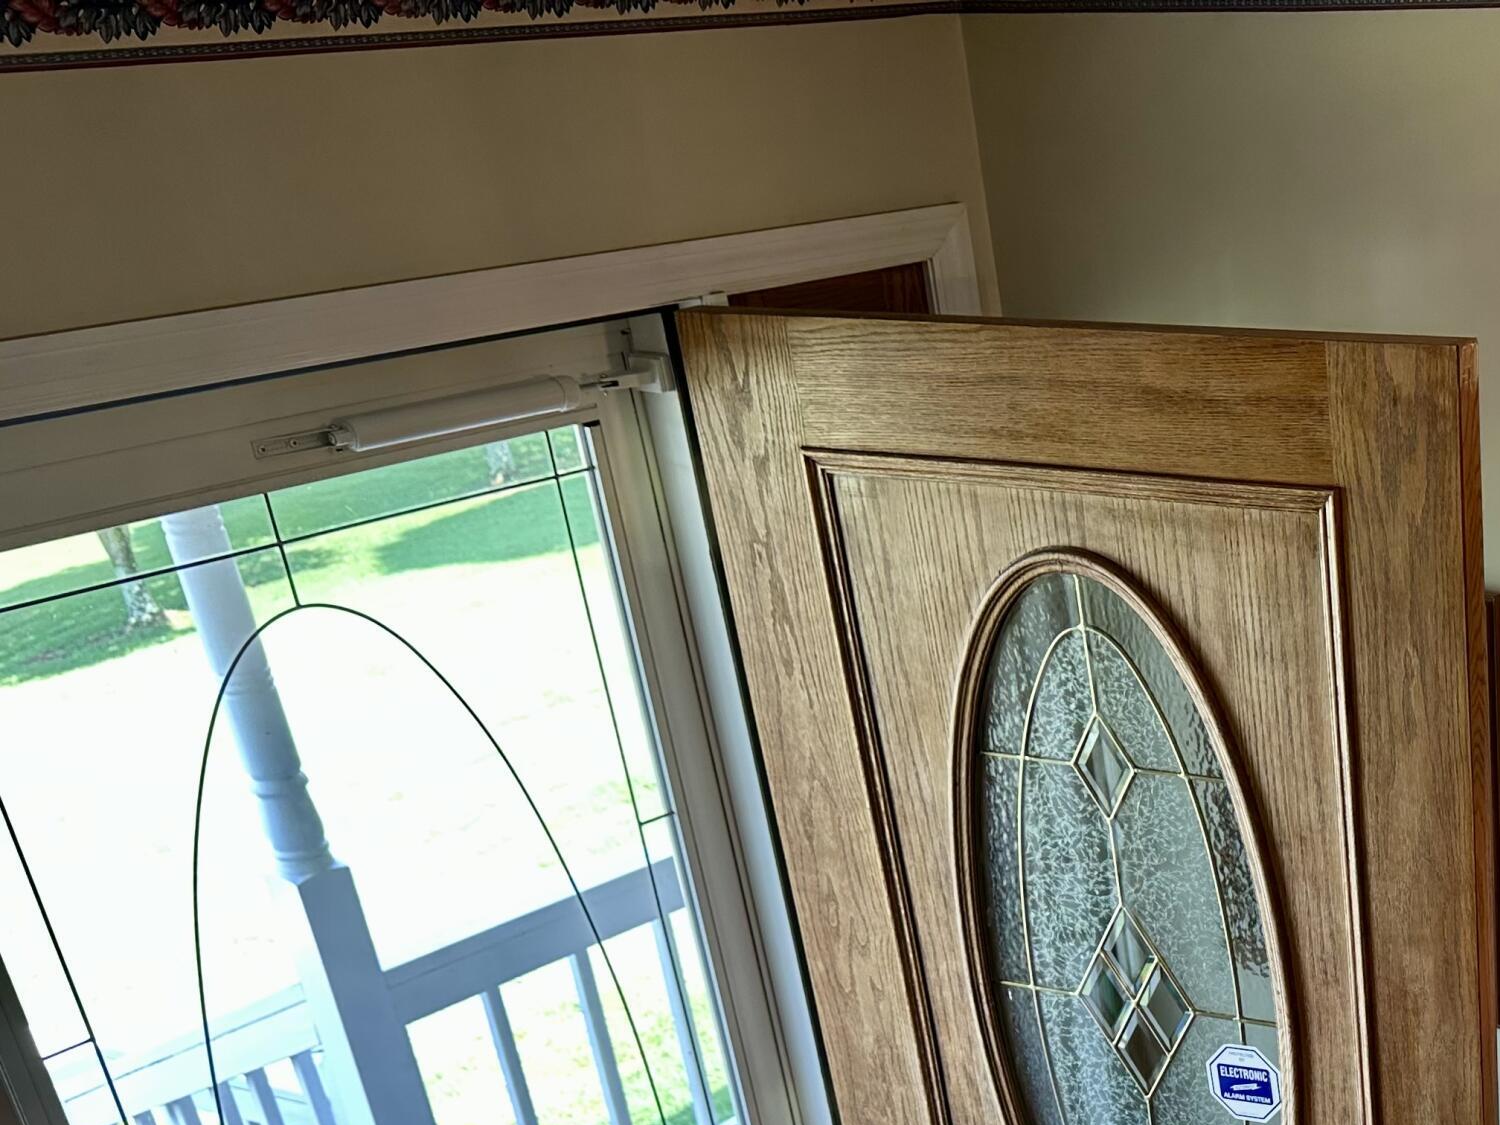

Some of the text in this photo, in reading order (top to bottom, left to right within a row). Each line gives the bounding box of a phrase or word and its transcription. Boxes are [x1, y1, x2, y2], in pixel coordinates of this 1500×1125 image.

[1219, 1065, 1269, 1082] ELECTRONIC
[1223, 1092, 1271, 1104] ALARM SYSTEM
